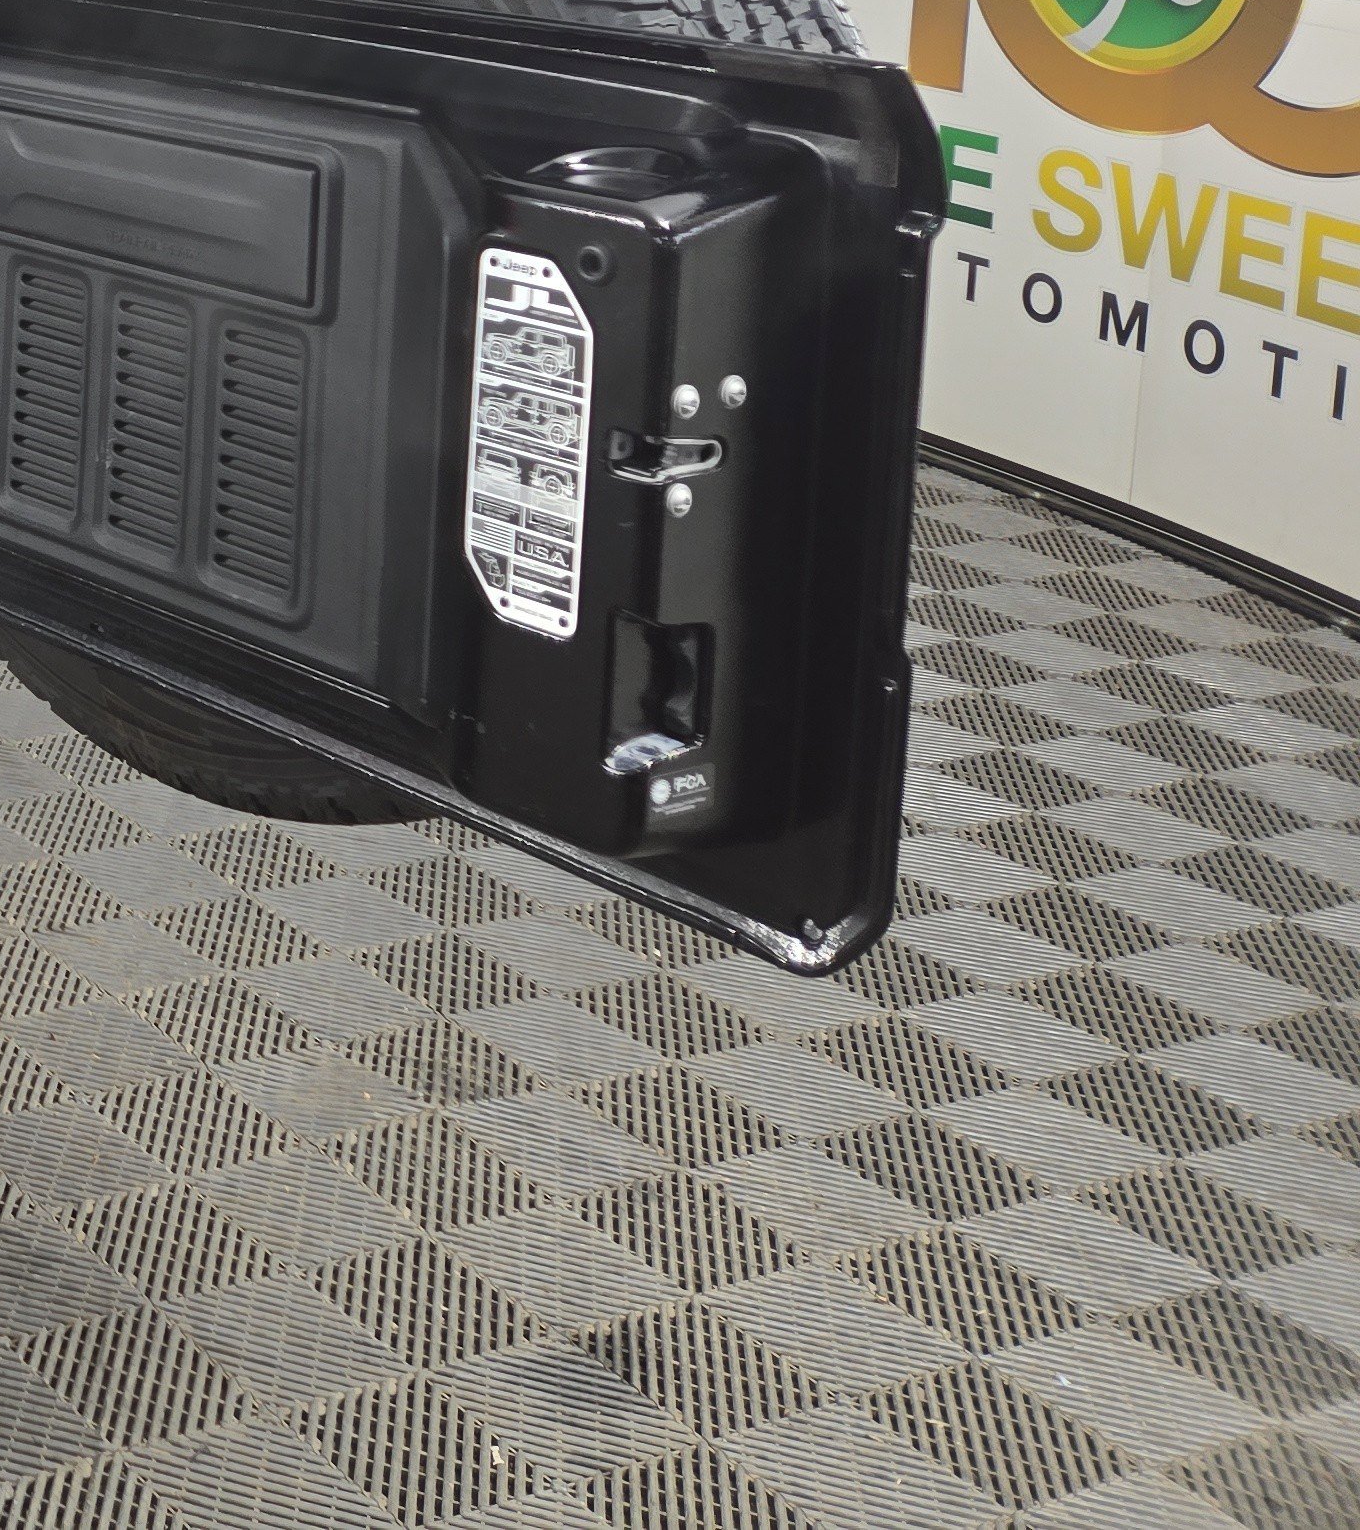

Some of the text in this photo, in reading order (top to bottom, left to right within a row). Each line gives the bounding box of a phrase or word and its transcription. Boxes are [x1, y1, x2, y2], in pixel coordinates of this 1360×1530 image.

[1032, 149, 1360, 337] SWEE
[502, 259, 538, 276] Jeep
[957, 251, 1348, 421] TOMOTI
[517, 539, 569, 568] USA
[673, 773, 707, 792] FCA
